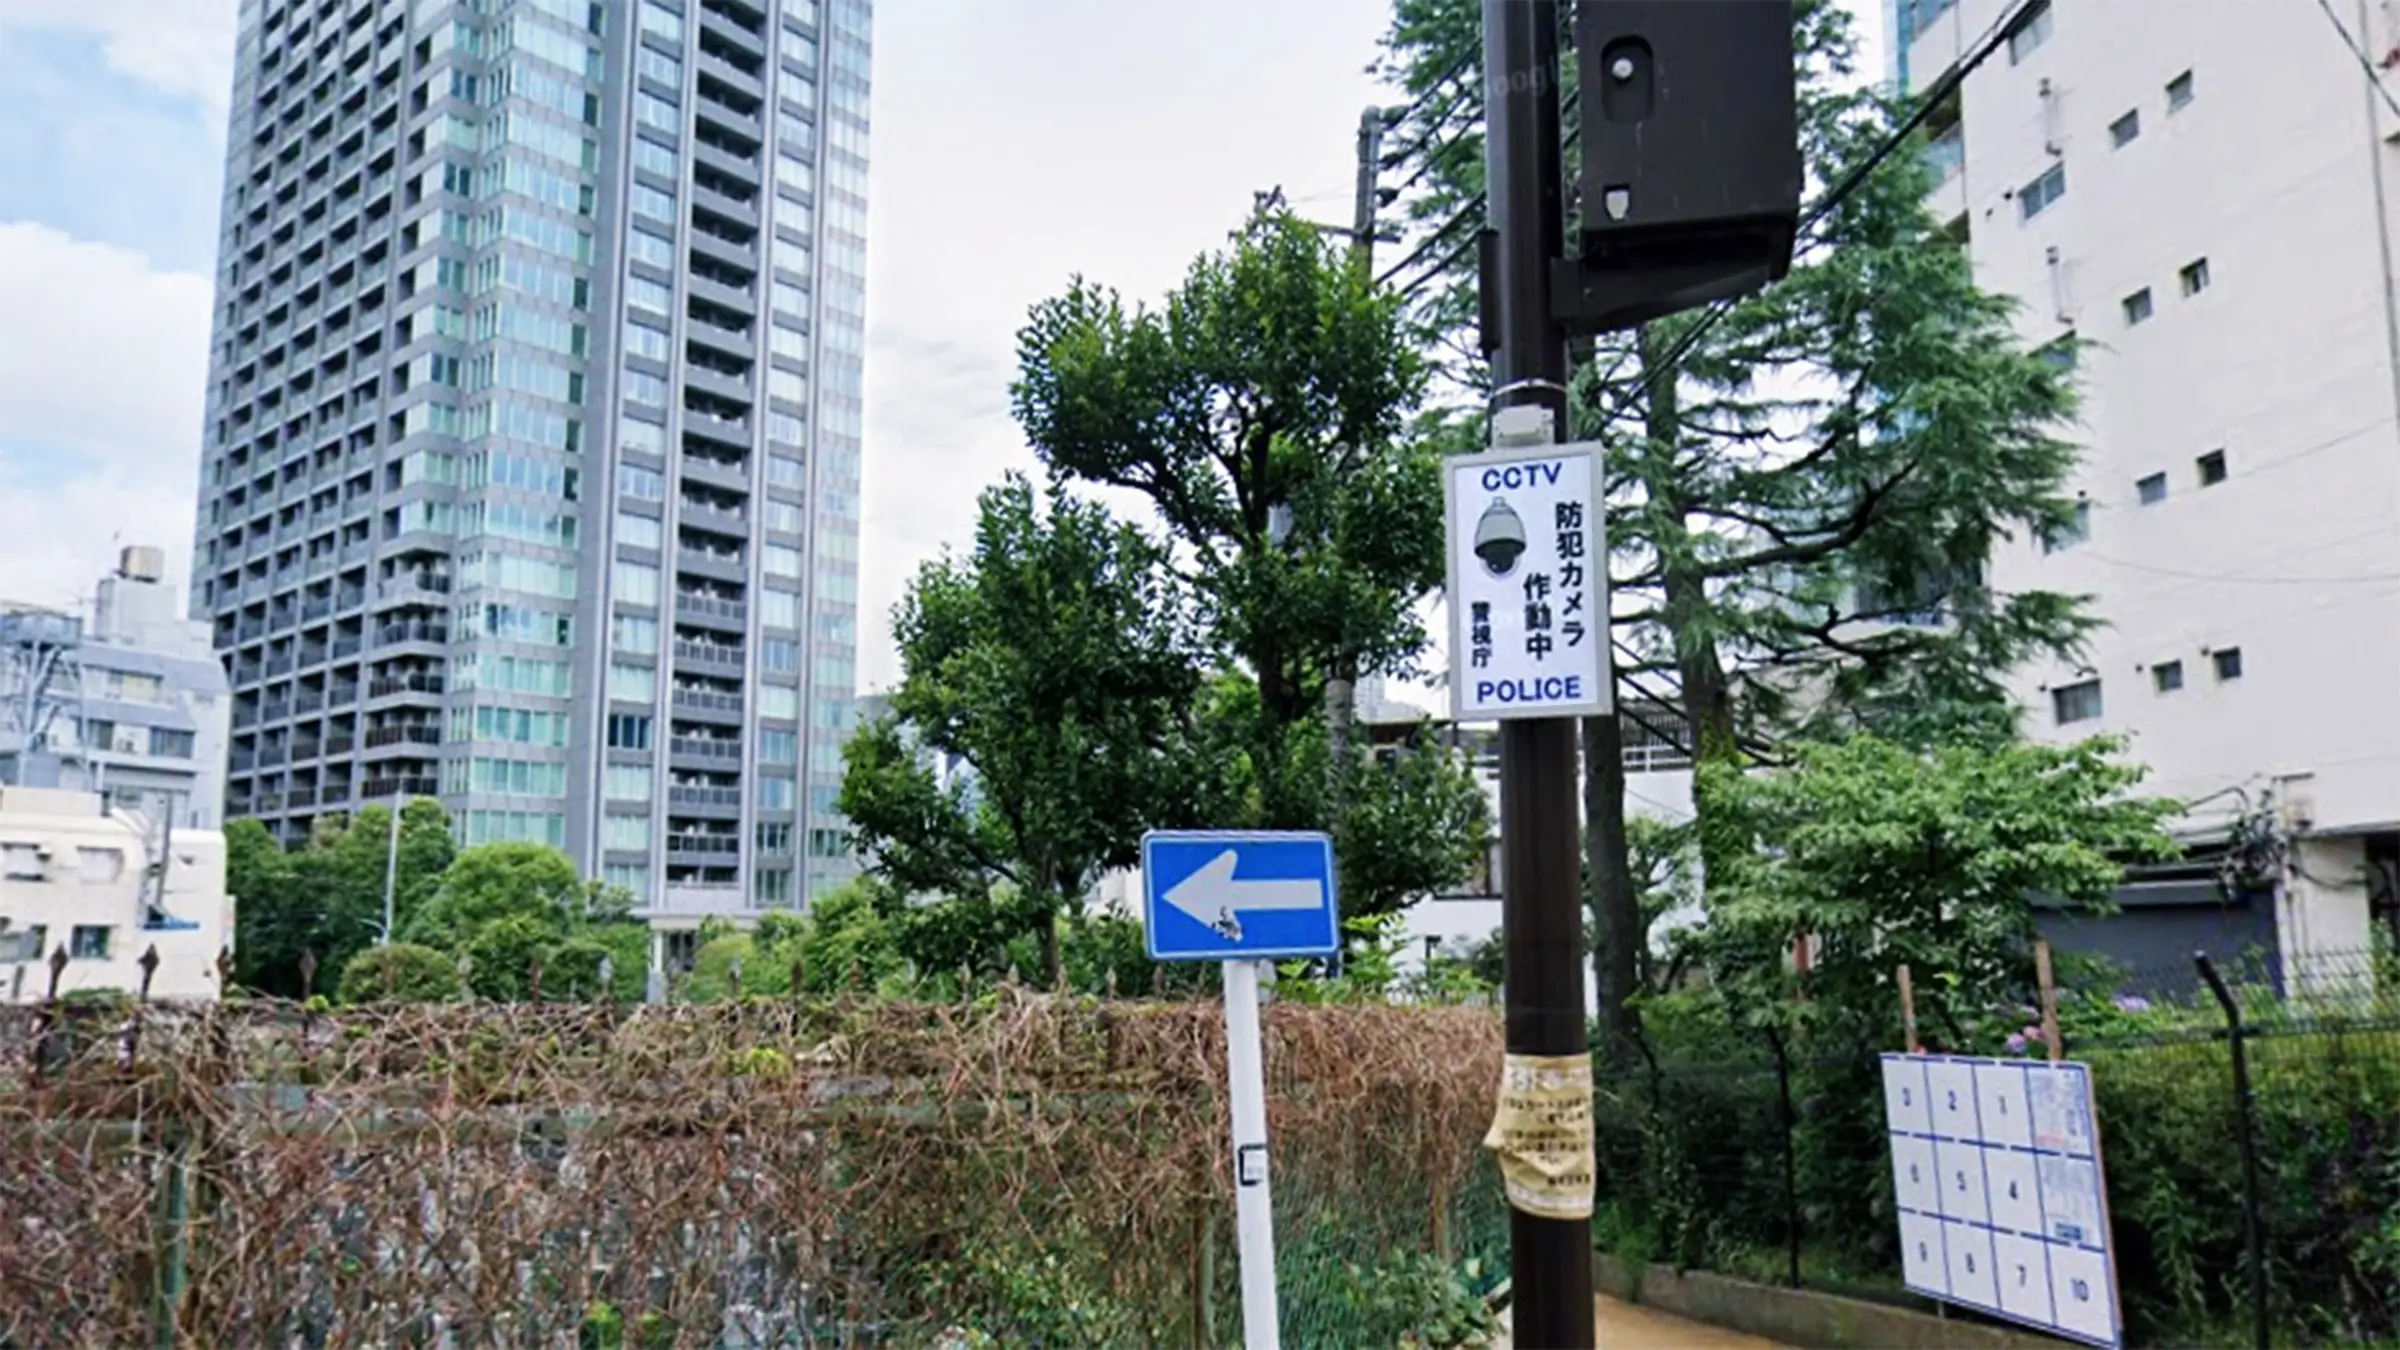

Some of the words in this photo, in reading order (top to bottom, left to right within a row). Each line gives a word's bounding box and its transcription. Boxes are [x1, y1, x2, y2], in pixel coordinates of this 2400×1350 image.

[1481, 462, 1562, 491] CCTV
[1555, 501, 1585, 647] 防犯カメラ
[1523, 573, 1552, 661] 作動中
[1477, 676, 1581, 702] POLICE
[1948, 1090, 1957, 1112] 2
[2016, 1264, 2026, 1287] 7
[2070, 1277, 2089, 1302] 10
